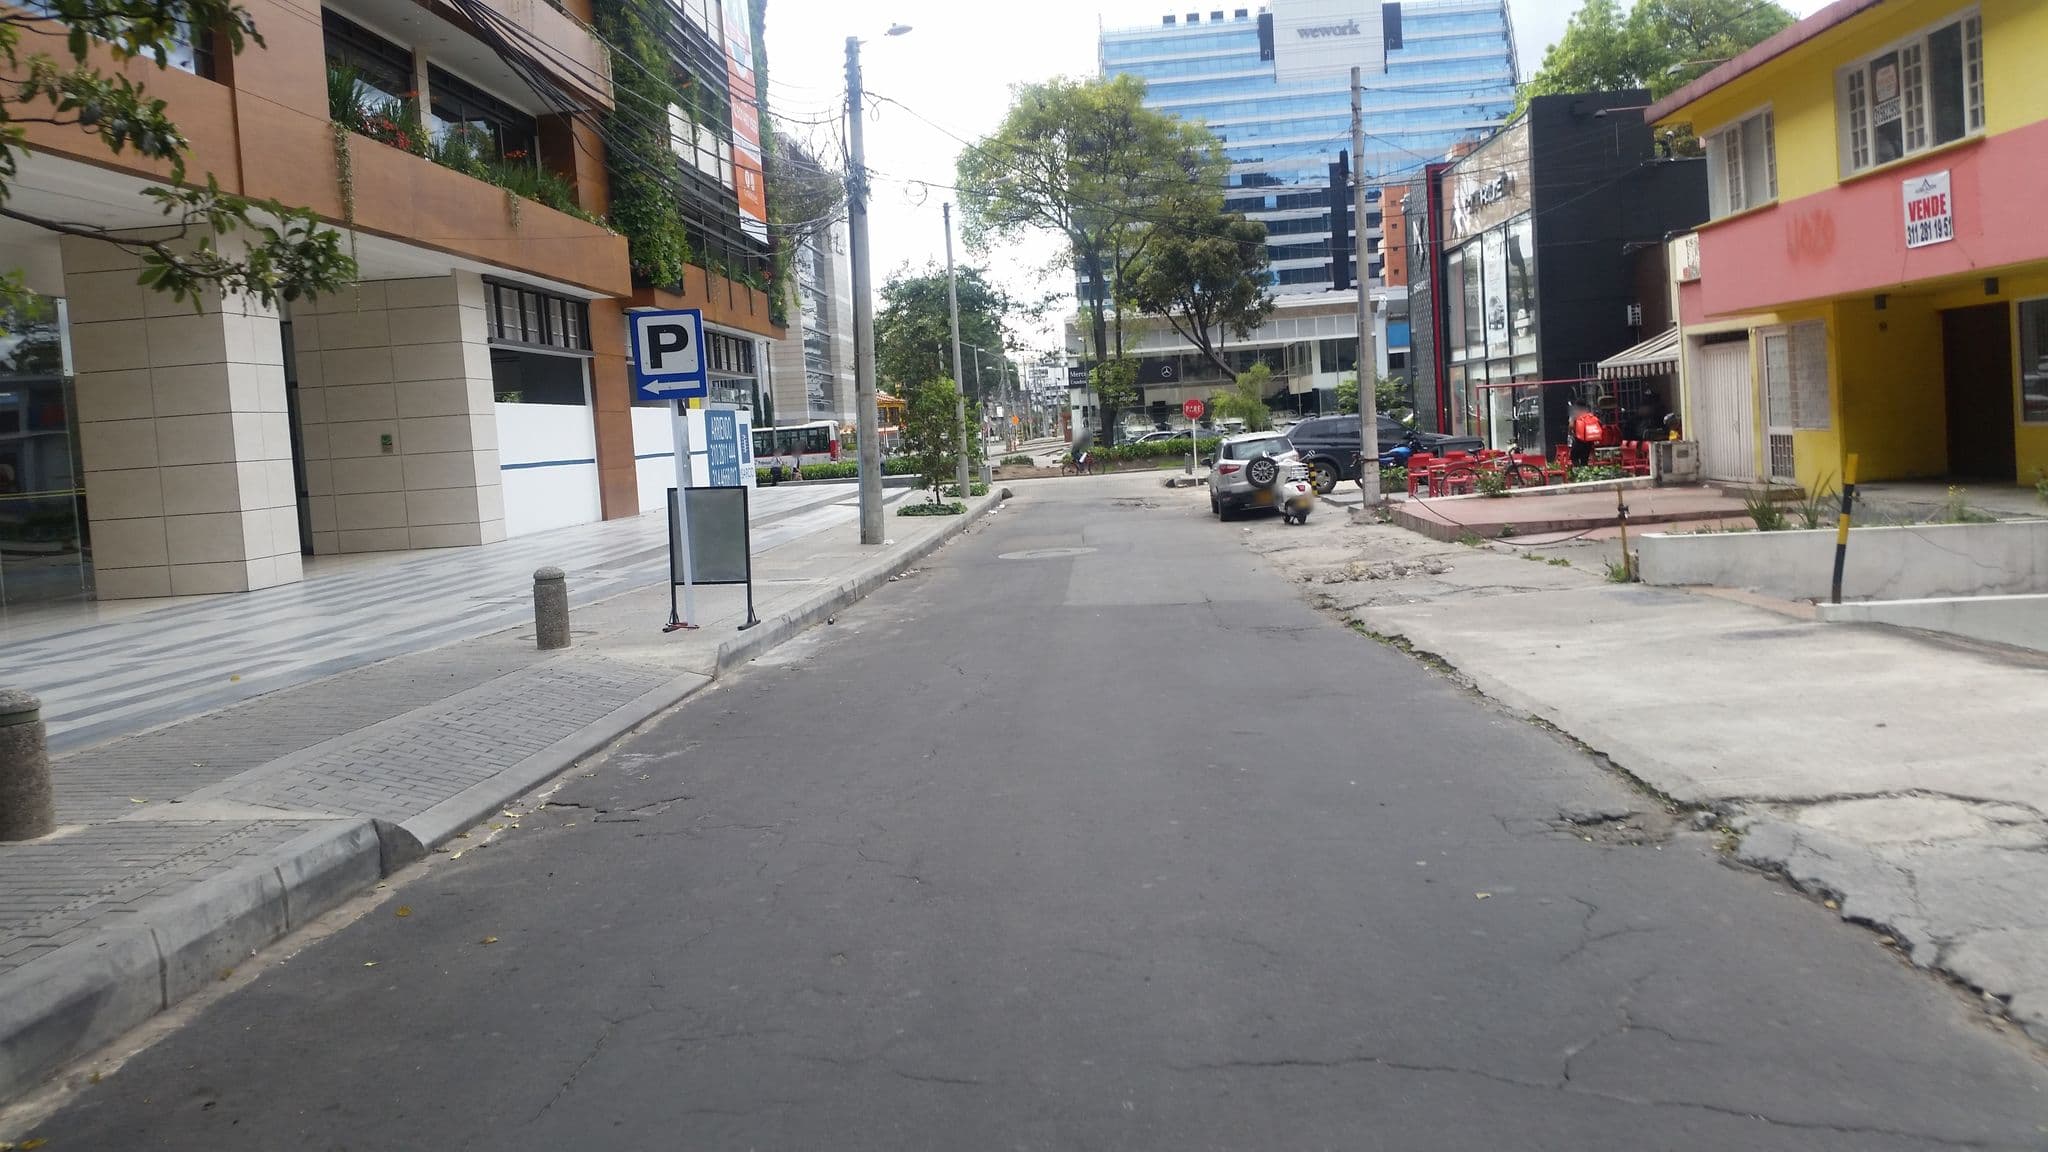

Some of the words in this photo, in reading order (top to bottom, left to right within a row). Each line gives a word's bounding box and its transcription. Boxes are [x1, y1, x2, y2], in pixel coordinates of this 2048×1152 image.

[1297, 19, 1361, 38] wework
[1908, 193, 1947, 222] VENDE
[1907, 224, 1919, 246] 311
[1920, 220, 1932, 242] 281
[1934, 217, 1943, 239] 19
[1944, 215, 1952, 237] 51
[647, 324, 689, 369] P
[711, 416, 733, 441] ARRIENDO
